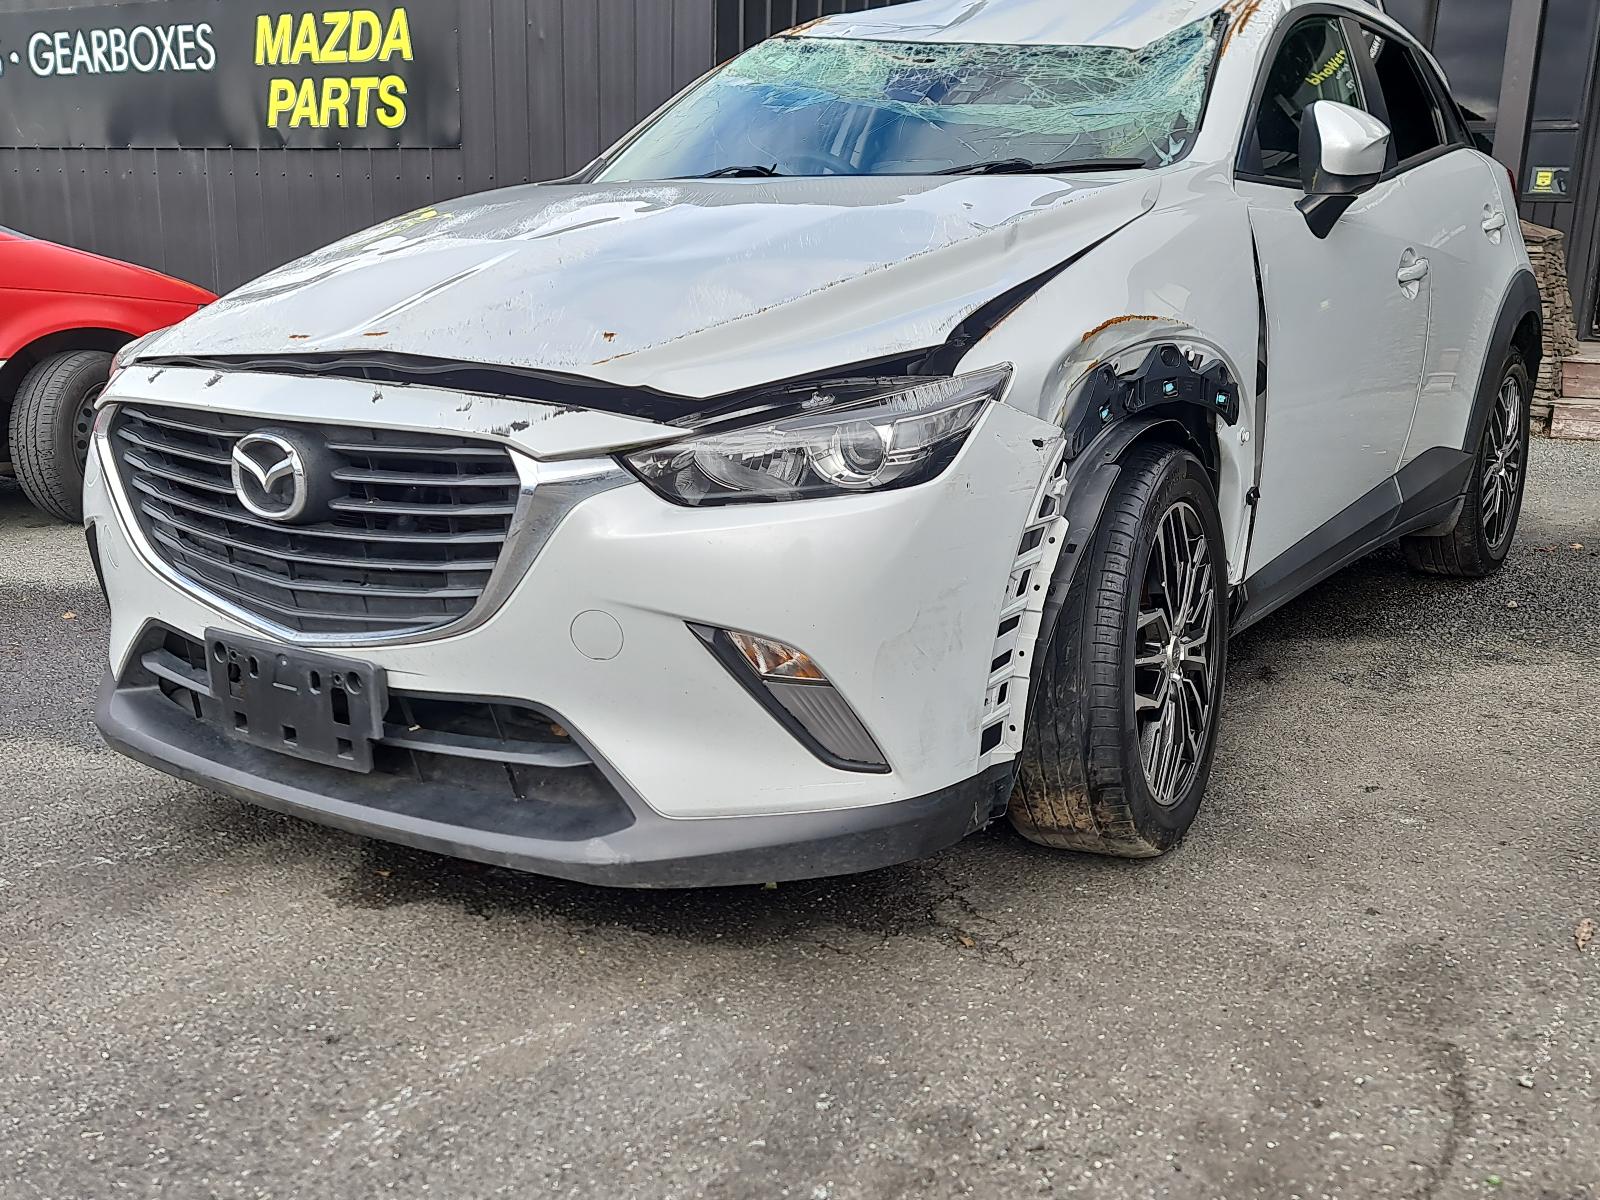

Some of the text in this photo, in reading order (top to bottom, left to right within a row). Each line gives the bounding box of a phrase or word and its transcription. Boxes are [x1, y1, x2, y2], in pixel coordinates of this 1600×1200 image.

[28, 23, 217, 76] GEARBOXES
[255, 7, 413, 66] MAZDA
[267, 75, 408, 129] PARTS
